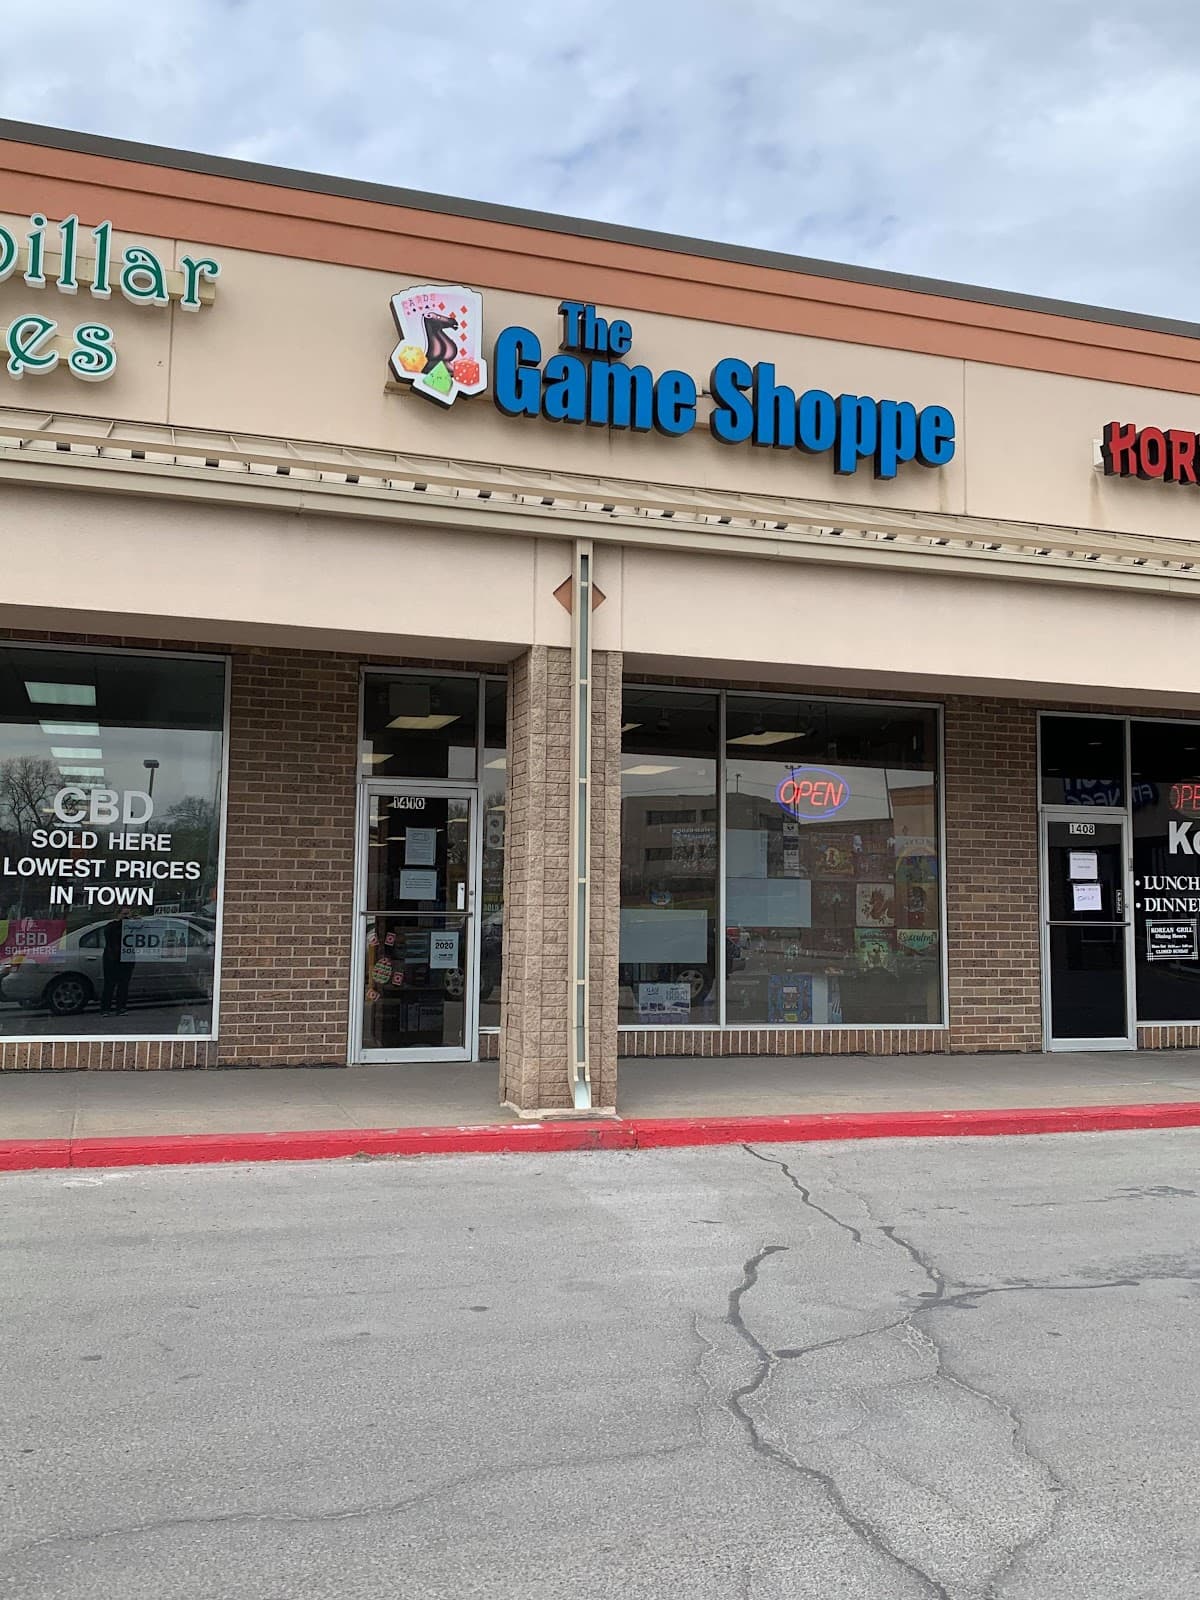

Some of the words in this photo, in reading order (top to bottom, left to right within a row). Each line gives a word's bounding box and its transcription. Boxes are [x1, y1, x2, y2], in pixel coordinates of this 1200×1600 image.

[558, 301, 632, 357] The
[494, 326, 696, 437] Game
[710, 358, 955, 480] Shoppe
[1100, 421, 1200, 485] KOR
[393, 797, 425, 809] 1410
[780, 780, 844, 806] OPEN
[54, 787, 153, 825] CBD
[1069, 823, 1095, 835] 1408
[32, 829, 98, 849] SOLD
[109, 832, 172, 851] HERE
[3, 857, 105, 878] LOWEST
[115, 860, 201, 880] PRICES
[1143, 875, 1200, 890] LUNCH
[50, 886, 74, 905] IN
[84, 887, 154, 906] TOWN
[15, 932, 48, 946] CBD
[122, 934, 160, 948] CBD
[435, 942, 454, 950] 2020
[5, 947, 31, 955] SOLD
[32, 946, 57, 955] HERE
